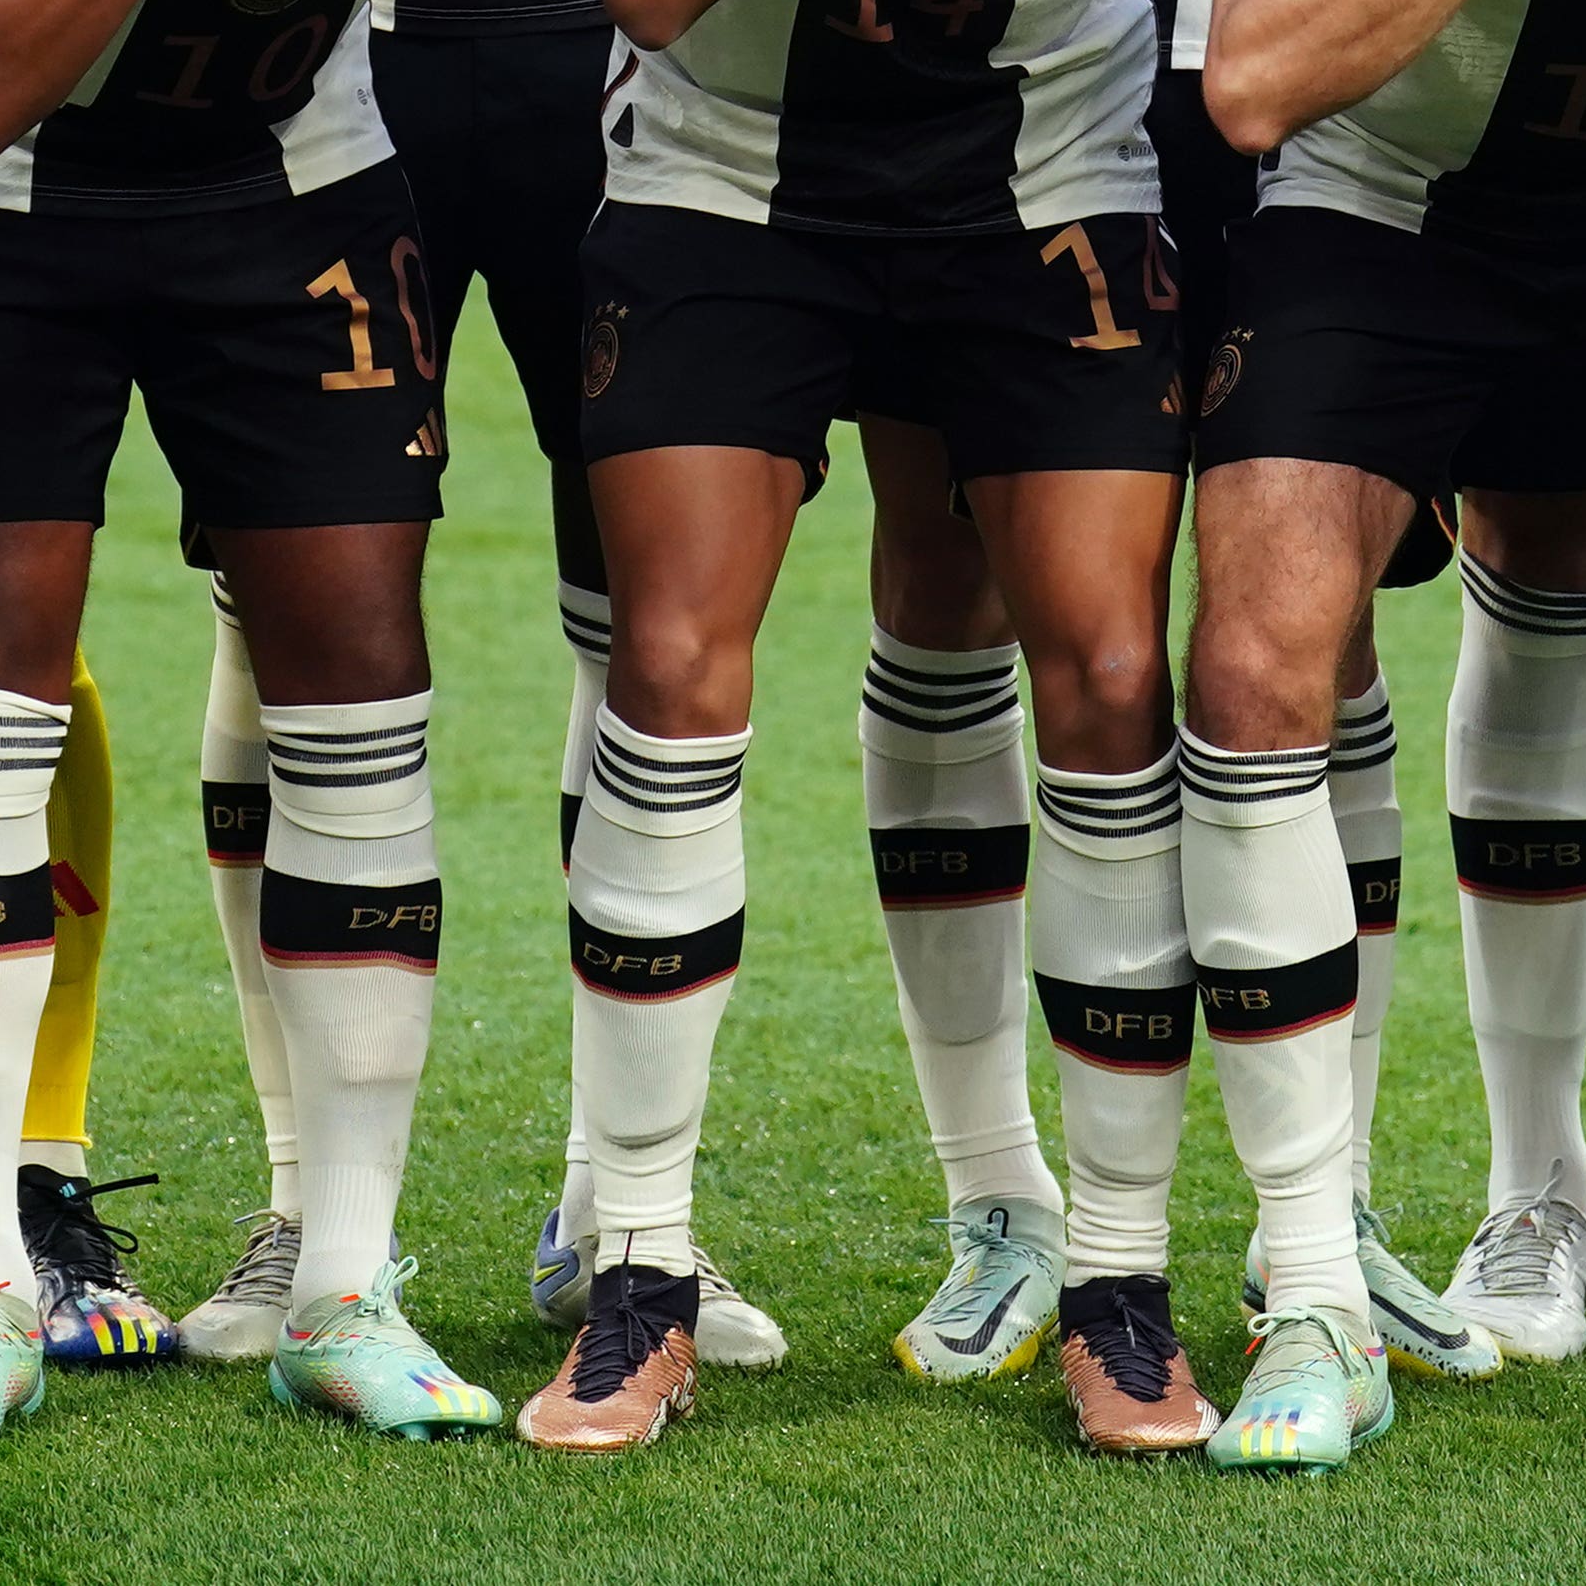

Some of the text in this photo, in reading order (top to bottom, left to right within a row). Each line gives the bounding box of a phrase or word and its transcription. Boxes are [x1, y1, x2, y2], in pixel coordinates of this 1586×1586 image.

[135, 15, 329, 108] 10
[304, 234, 437, 392] 10
[880, 851, 969, 874] DFB
[1488, 842, 1582, 870] DFB
[348, 905, 438, 932] DFB
[583, 941, 683, 976] DFB
[1085, 1007, 1172, 1040] DFB
